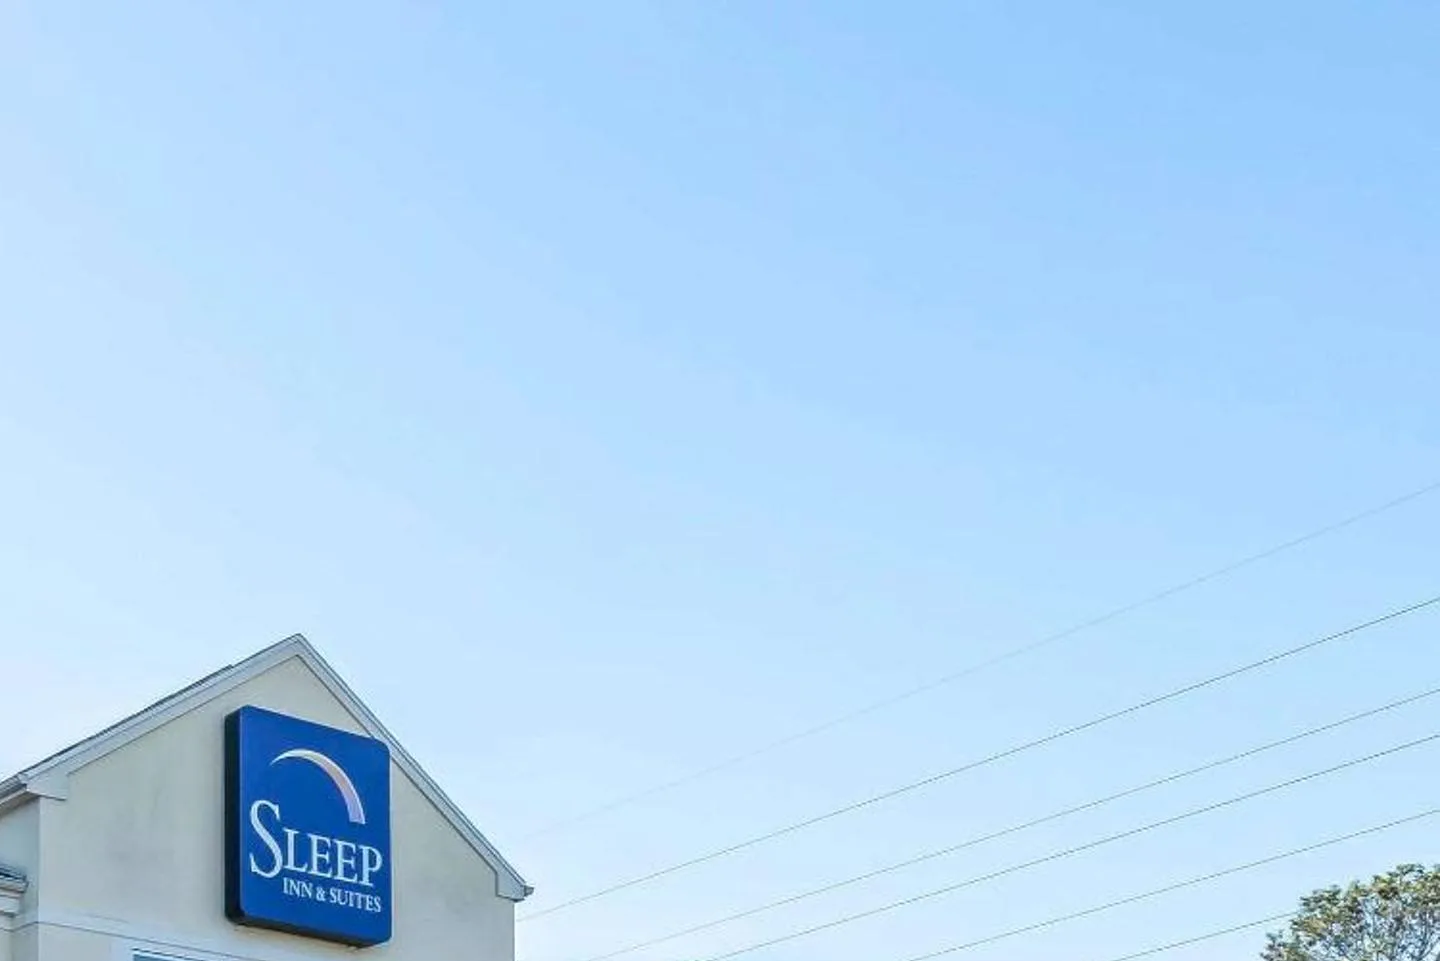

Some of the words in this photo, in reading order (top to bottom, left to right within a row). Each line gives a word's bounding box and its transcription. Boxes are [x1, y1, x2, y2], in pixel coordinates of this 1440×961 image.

[250, 800, 382, 887] SLEEP
[283, 877, 313, 899] INN
[316, 885, 326, 902] &
[329, 887, 382, 913] SUITES
